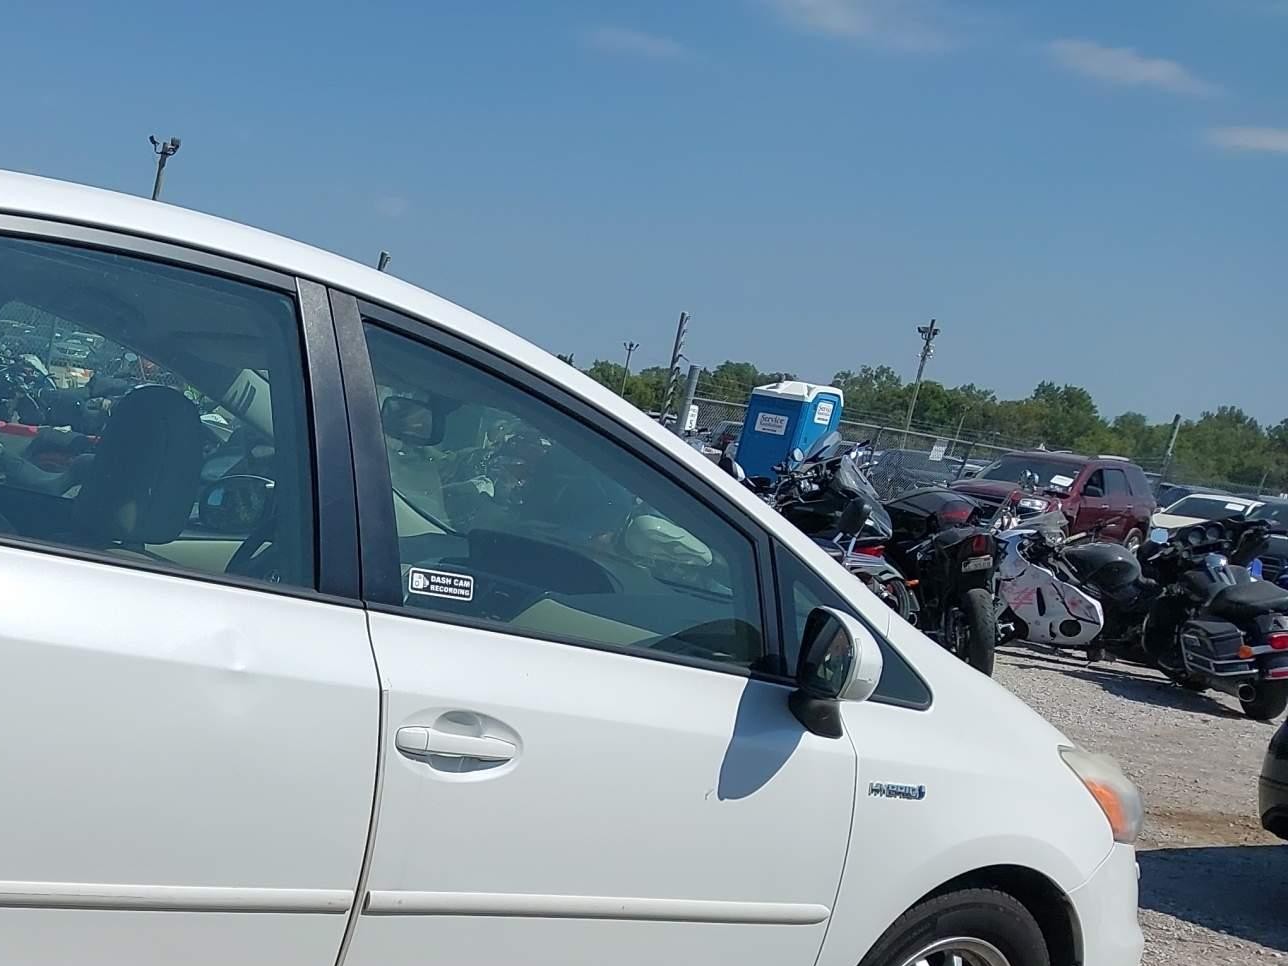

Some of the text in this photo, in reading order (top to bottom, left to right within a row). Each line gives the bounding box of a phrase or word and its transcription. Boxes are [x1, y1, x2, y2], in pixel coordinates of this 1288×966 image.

[430, 575, 471, 588] DASH CAM
[430, 585, 470, 596] RECORDING
